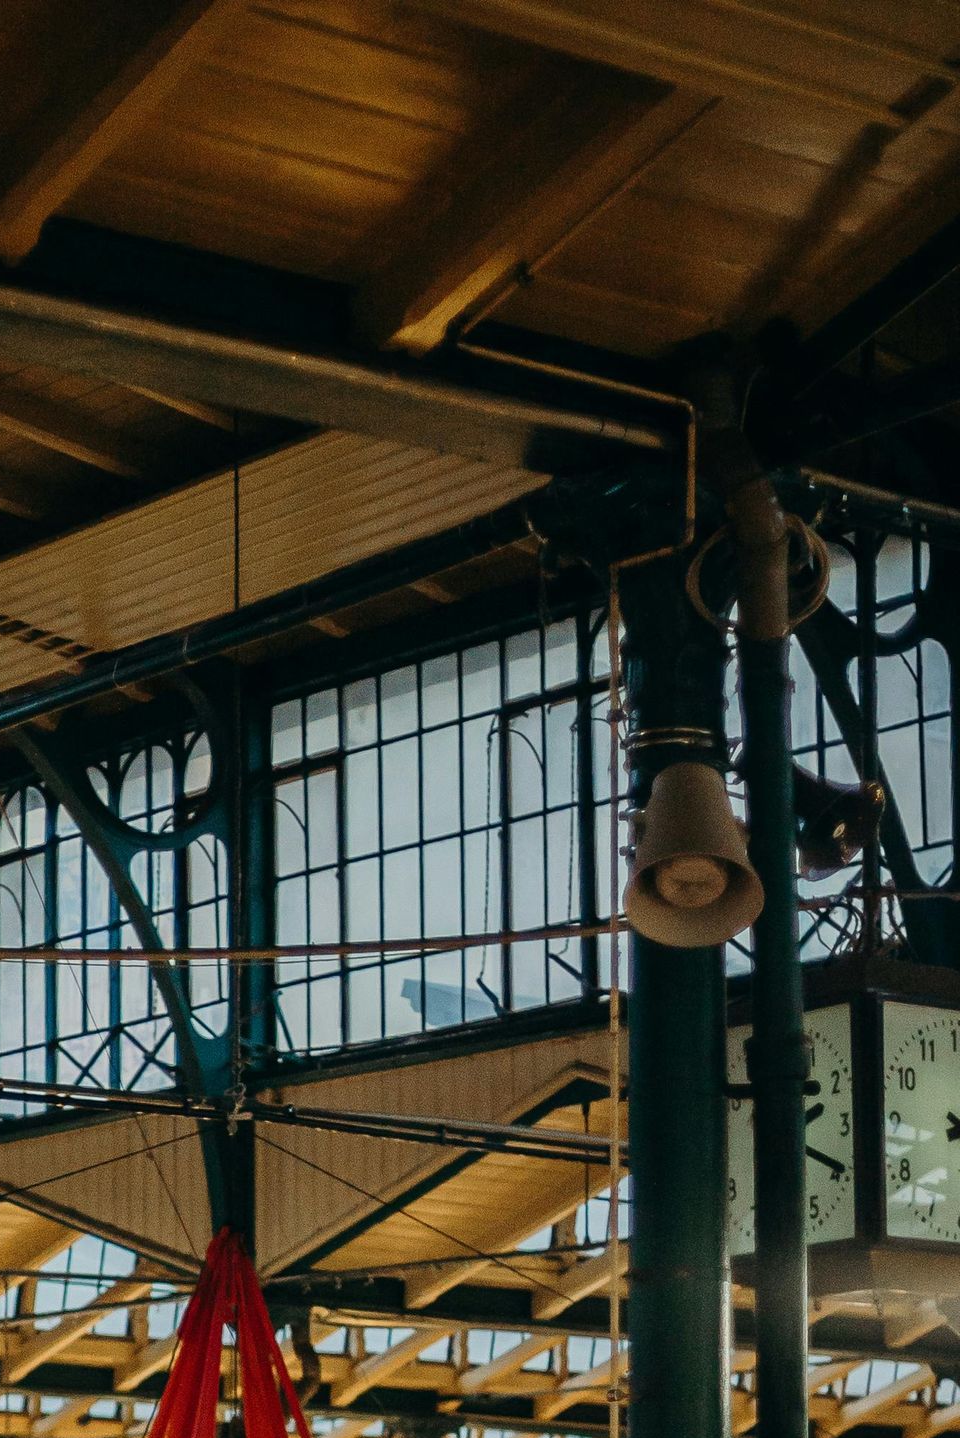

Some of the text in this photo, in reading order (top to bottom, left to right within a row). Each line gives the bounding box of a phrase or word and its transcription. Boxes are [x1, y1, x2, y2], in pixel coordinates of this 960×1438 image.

[920, 1038, 936, 1062] 11
[950, 1029, 960, 1053] 1
[830, 1069, 841, 1095] 2
[898, 1066, 916, 1092] 10
[839, 1111, 850, 1137] 3
[899, 1157, 911, 1182] 8
[808, 1194, 819, 1219] 5
